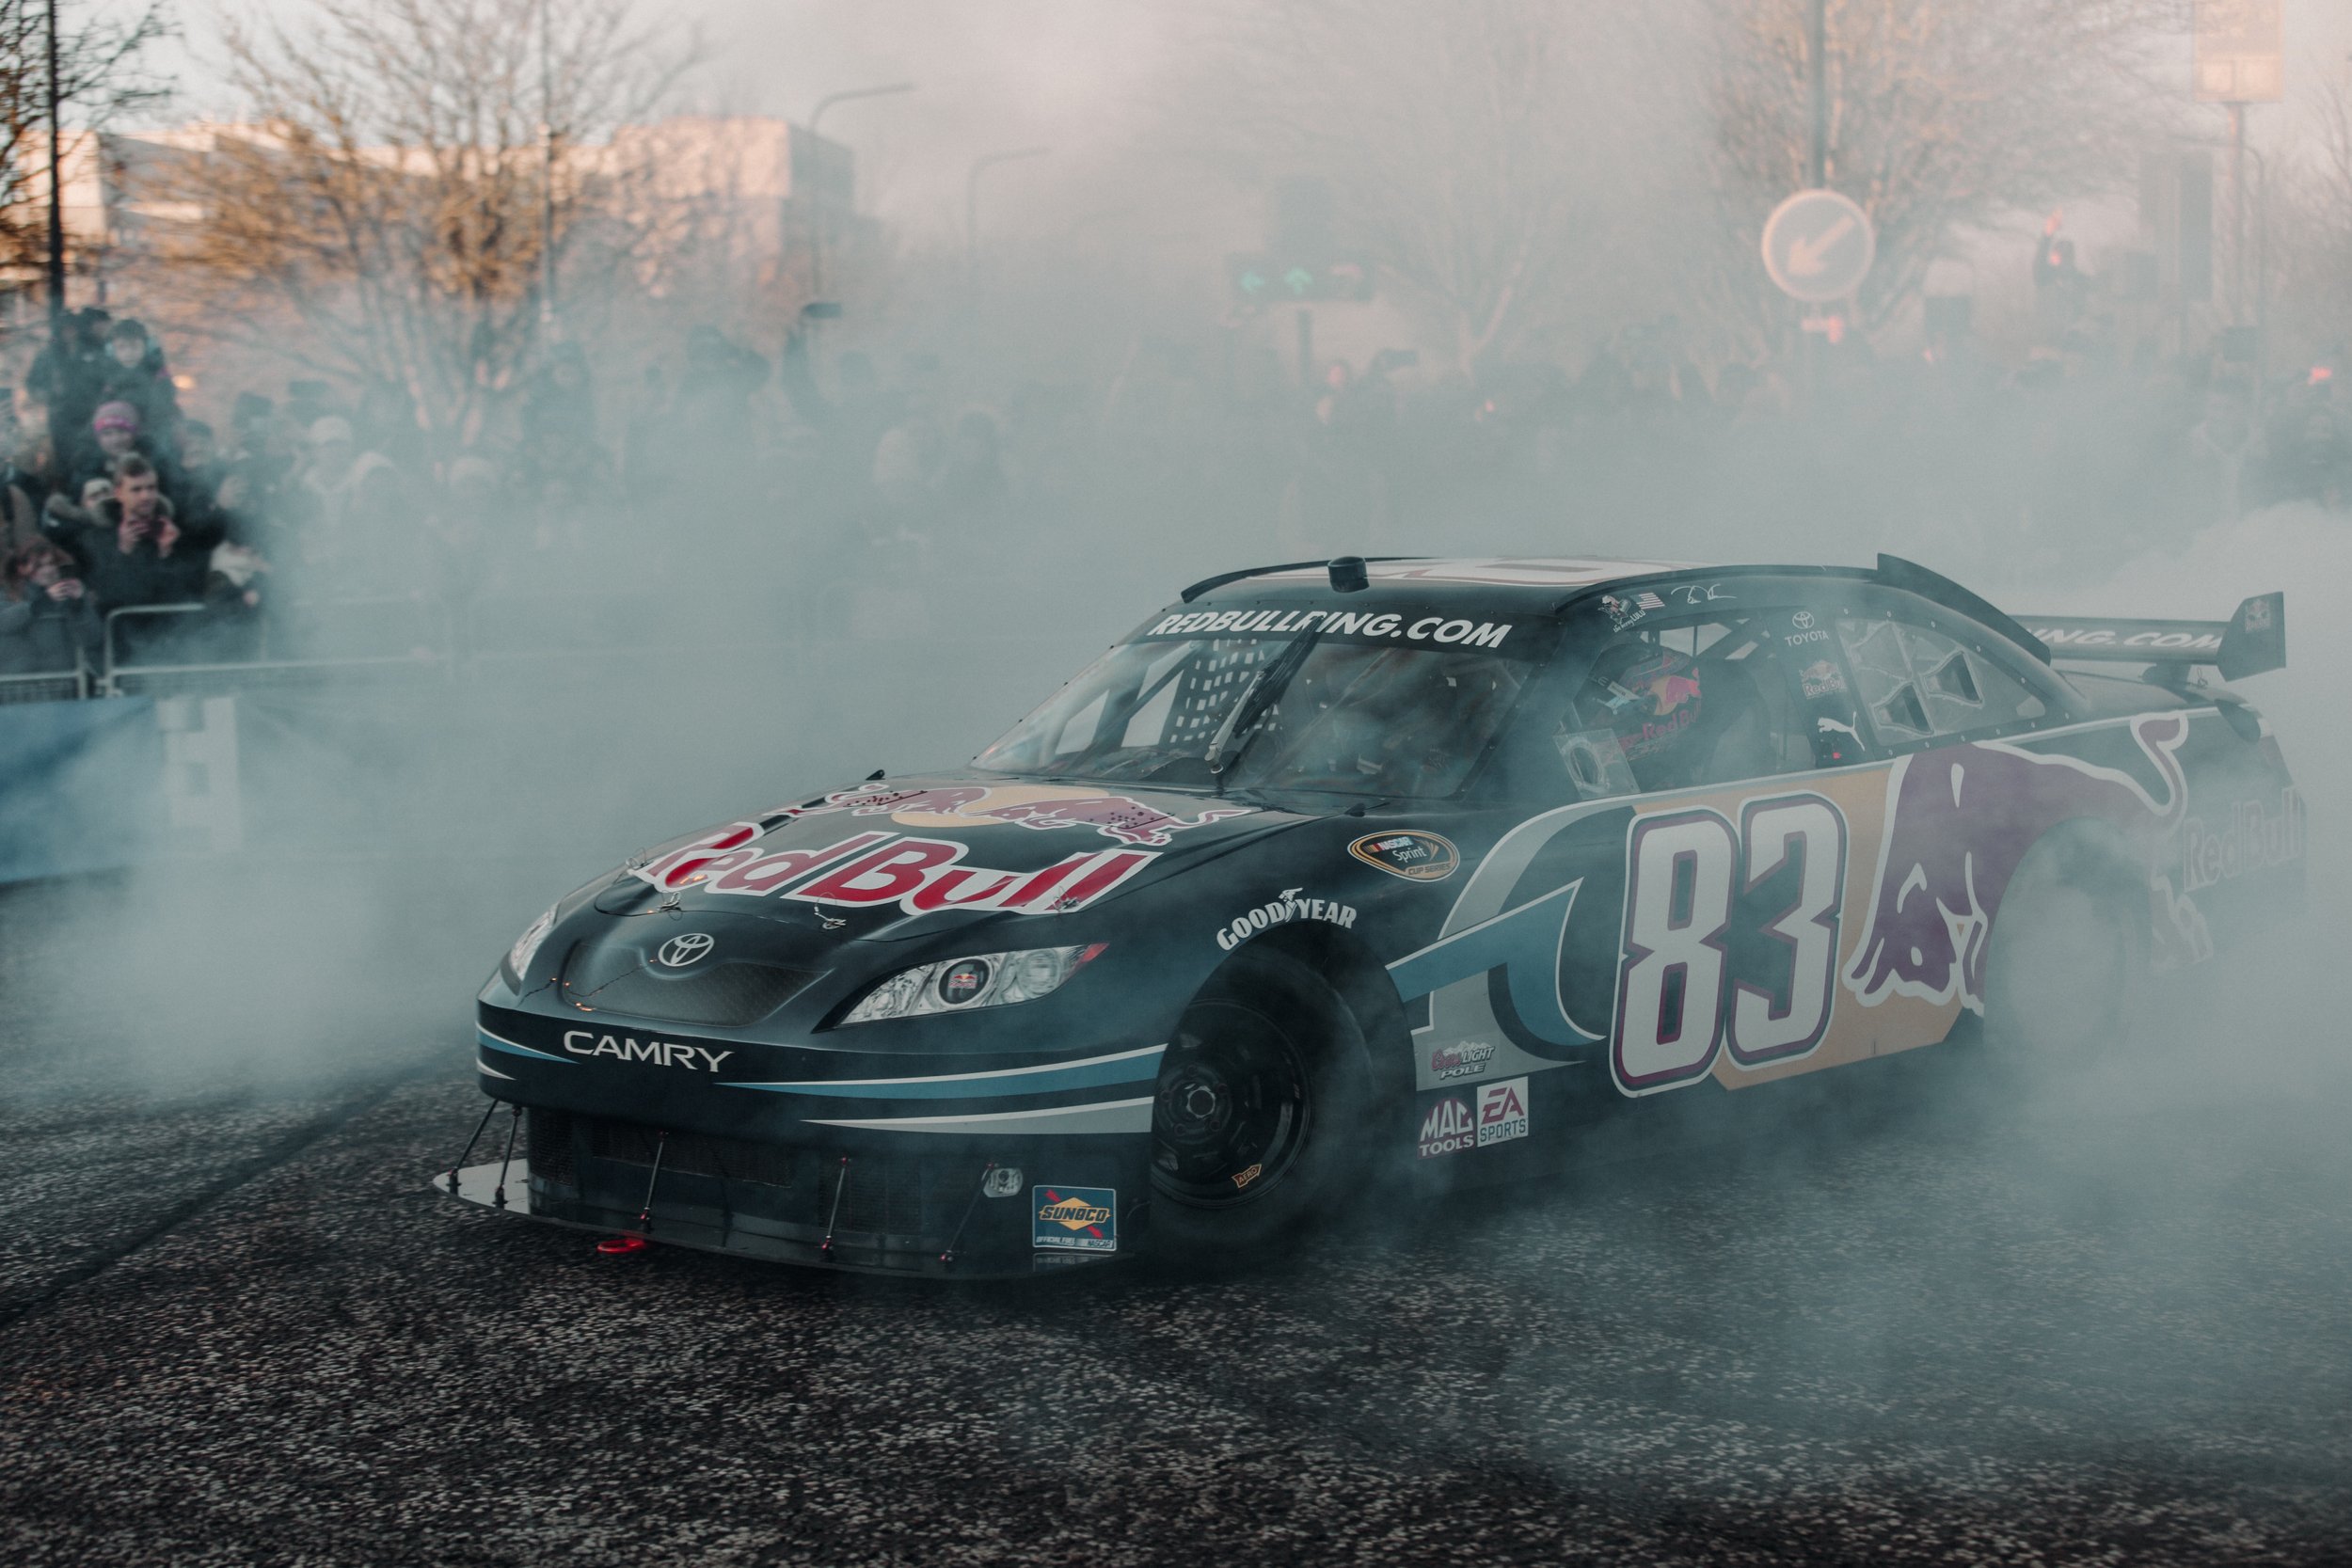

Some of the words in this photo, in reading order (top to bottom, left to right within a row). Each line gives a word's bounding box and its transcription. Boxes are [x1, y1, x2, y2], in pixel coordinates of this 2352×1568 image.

[1147, 610, 1513, 649] REDBULLRING.COM
[1785, 630, 1829, 647] TOYOTA
[1802, 678, 1829, 697] Red
[1378, 835, 1413, 851] NASCAR
[1391, 846, 1427, 863] Sprint
[628, 822, 899, 896] Red
[781, 836, 1164, 915] Bull
[1407, 866, 1423, 876] CUP
[1424, 863, 1451, 875] SERIES
[1216, 894, 1357, 951] GOODYEAR
[1613, 793, 1847, 1094] 83
[564, 1031, 735, 1072] CAMRY
[1461, 1046, 1495, 1066] LIGHT
[1439, 1063, 1485, 1080] POLE
[1481, 1086, 1524, 1125] EA
[1420, 1100, 1474, 1142] MAC
[1479, 1118, 1526, 1143] SPORTS
[1419, 1134, 1474, 1157] TOOLS
[1041, 1206, 1108, 1222] SUNOCO
